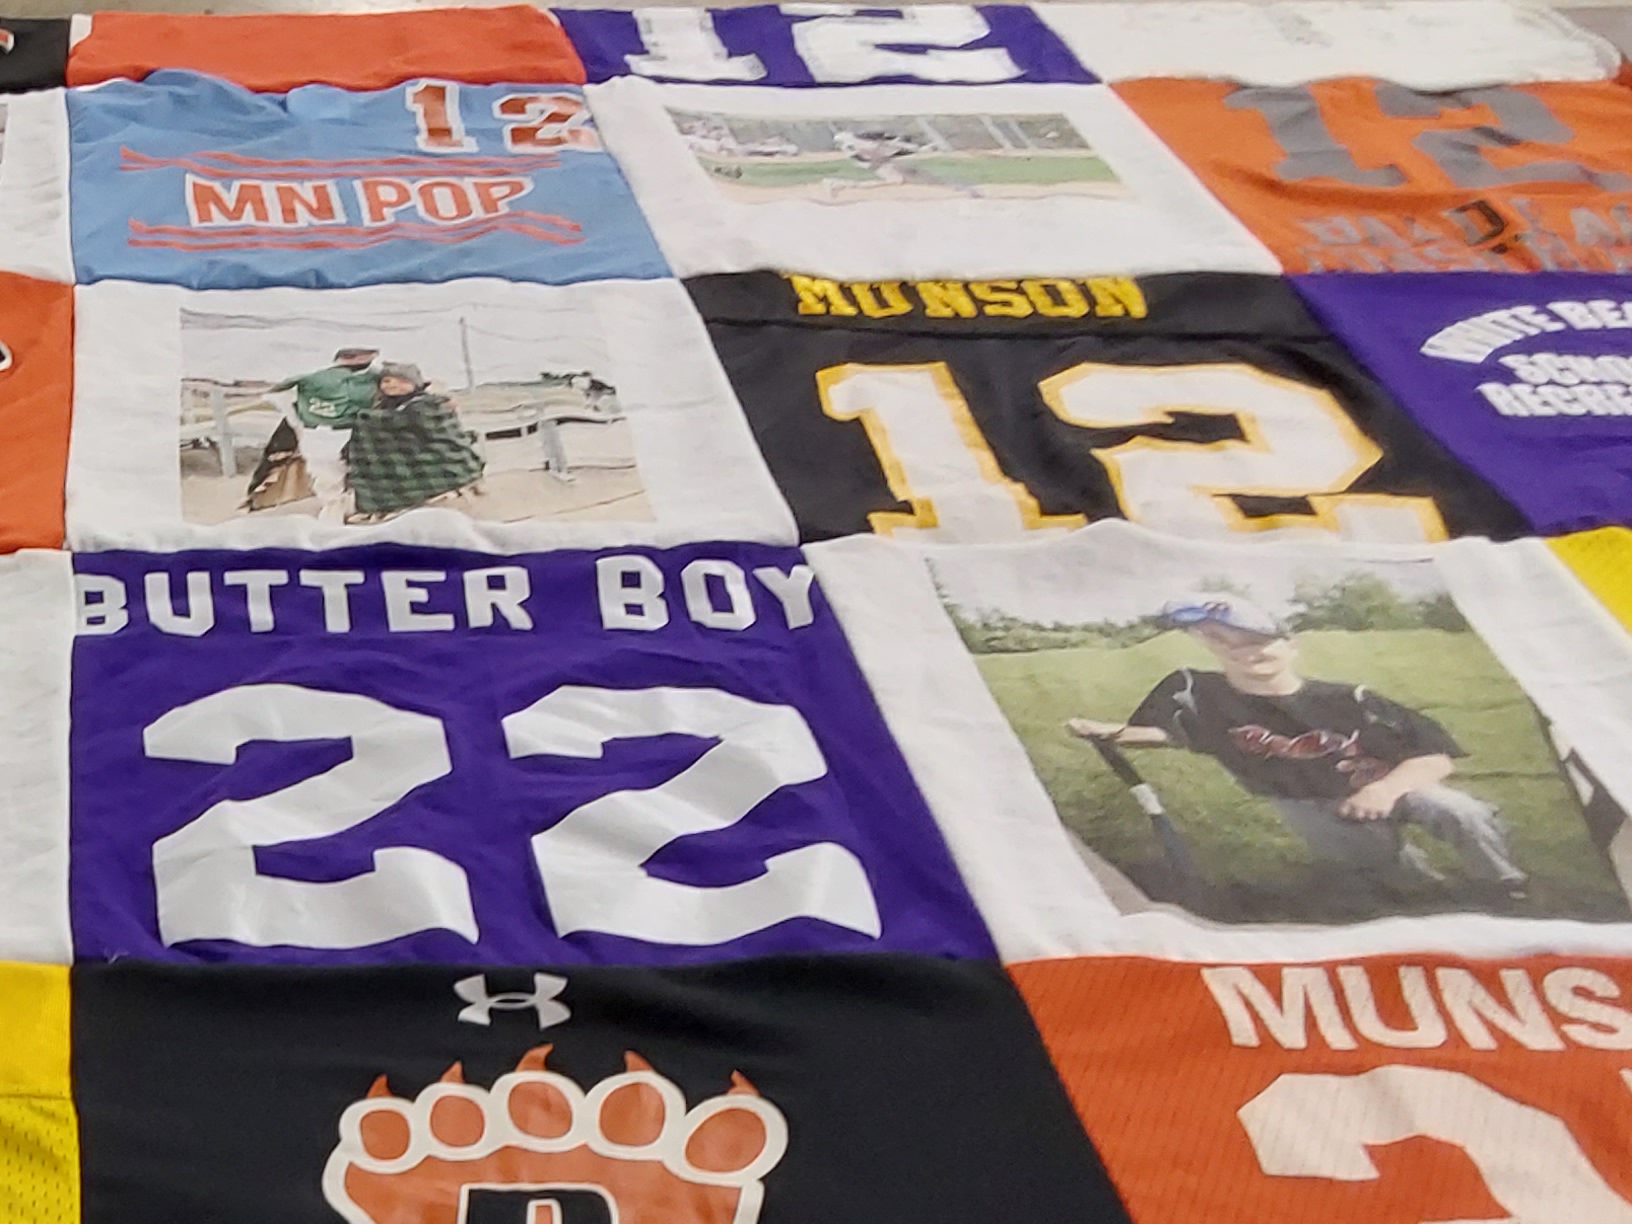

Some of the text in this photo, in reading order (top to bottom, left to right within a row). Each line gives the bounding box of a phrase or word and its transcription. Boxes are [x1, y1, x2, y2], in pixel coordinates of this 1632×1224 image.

[405, 78, 603, 154] 12
[185, 173, 535, 227] MN POP
[784, 272, 1149, 319] MUNSON
[1546, 299, 1632, 330] BE
[1474, 381, 1632, 417] RECRE
[815, 361, 1449, 542] 12
[74, 554, 816, 637] BUTTER BOY
[143, 682, 882, 951] 22
